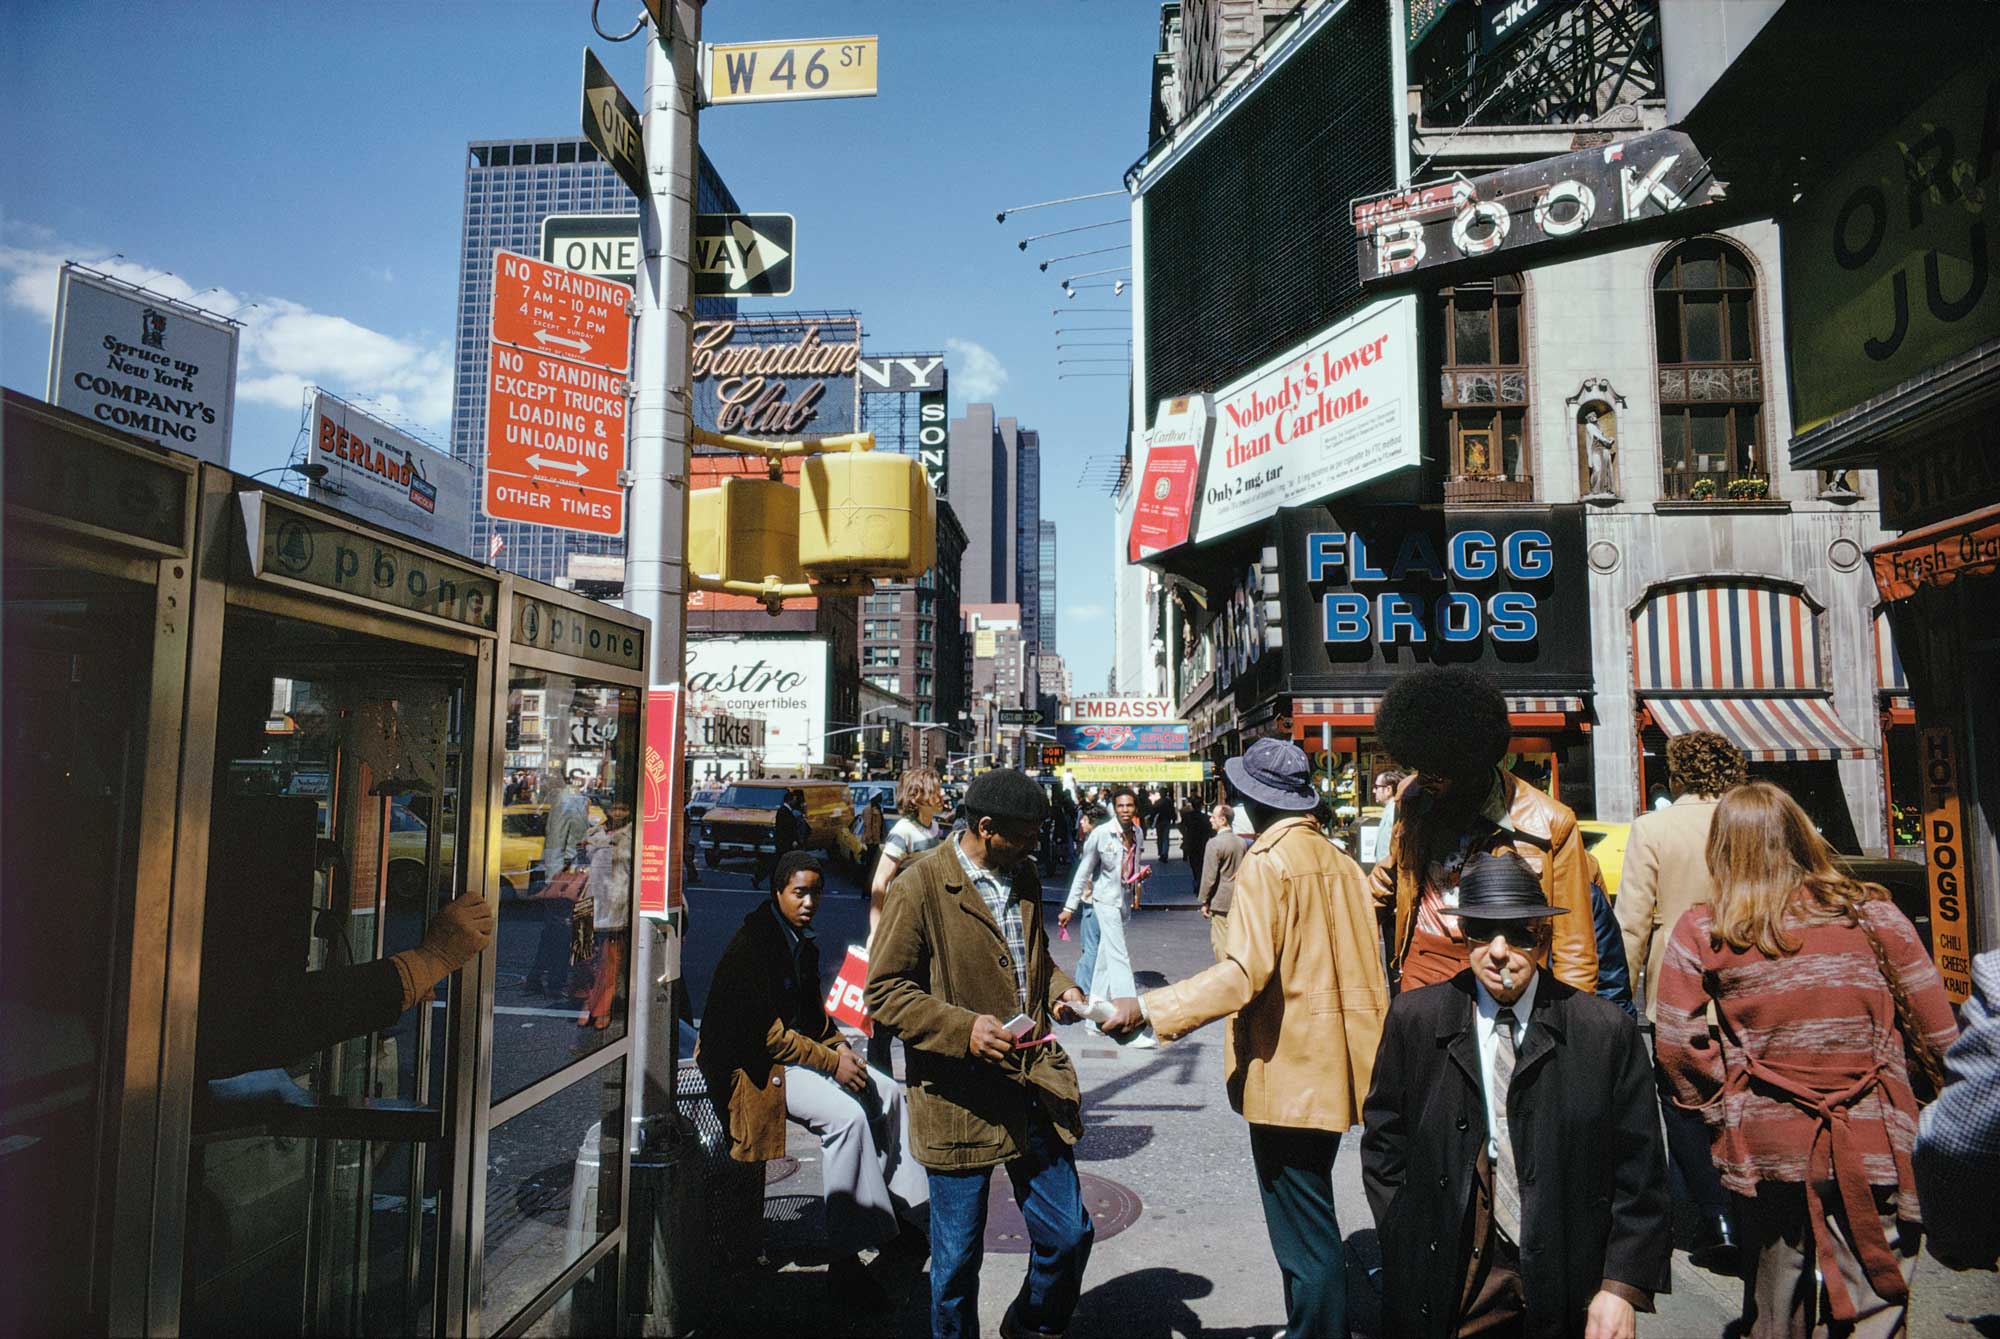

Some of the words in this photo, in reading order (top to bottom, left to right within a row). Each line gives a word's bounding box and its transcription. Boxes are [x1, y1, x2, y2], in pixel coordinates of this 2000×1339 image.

[726, 52, 757, 94] W
[769, 48, 829, 90] 46
[840, 45, 866, 67] ST
[602, 99, 639, 165] ONE
[566, 241, 635, 270] ONE
[505, 259, 531, 281] NO
[543, 270, 624, 306] STANDING
[522, 285, 530, 298] 7
[533, 289, 553, 304] AM
[571, 297, 584, 313] 10
[588, 305, 607, 318] AM
[520, 302, 528, 315] 4
[534, 307, 553, 320] PM
[574, 314, 581, 328] 7
[587, 321, 605, 334] PM
[534, 320, 560, 331] EXCEPT
[567, 328, 594, 339] SUNDAY
[103, 335, 171, 367] Spruce
[174, 358, 198, 377] up
[693, 321, 858, 377] Canadian
[106, 354, 149, 379] New
[154, 367, 193, 392] York
[499, 351, 523, 373] NO
[538, 361, 621, 395] STANDING
[1225, 361, 1318, 436] Nobody's
[1323, 334, 1389, 388] lower
[74, 372, 215, 424] COMPANY'S
[495, 375, 557, 403] EXCEPT
[563, 390, 623, 418] TRUCKS
[716, 377, 825, 433] Club
[94, 403, 197, 442] COMING
[510, 402, 586, 433] LOADING
[594, 420, 607, 438] &
[1226, 433, 1271, 469] than
[1275, 388, 1368, 445] Carlton.
[319, 414, 410, 487] BERLAND
[506, 425, 609, 460] UNLOADING
[496, 487, 551, 509] OTHER
[560, 498, 612, 519] TIMES
[1207, 482, 1232, 504] Only
[1236, 477, 1242, 495] 2
[1266, 465, 1283, 482] tar
[1306, 530, 1552, 583] FLAGG
[1892, 543, 1947, 580] Fresh
[551, 618, 633, 656] phone
[1322, 592, 1537, 643] BROS
[727, 698, 807, 711] convertibles
[1075, 701, 1170, 717] EMBASSY
[1933, 820, 1960, 922] DOGS
[1940, 933, 1961, 951] CHILI
[1941, 954, 1969, 975] CHEESE
[1943, 976, 1969, 996] KRAUT
